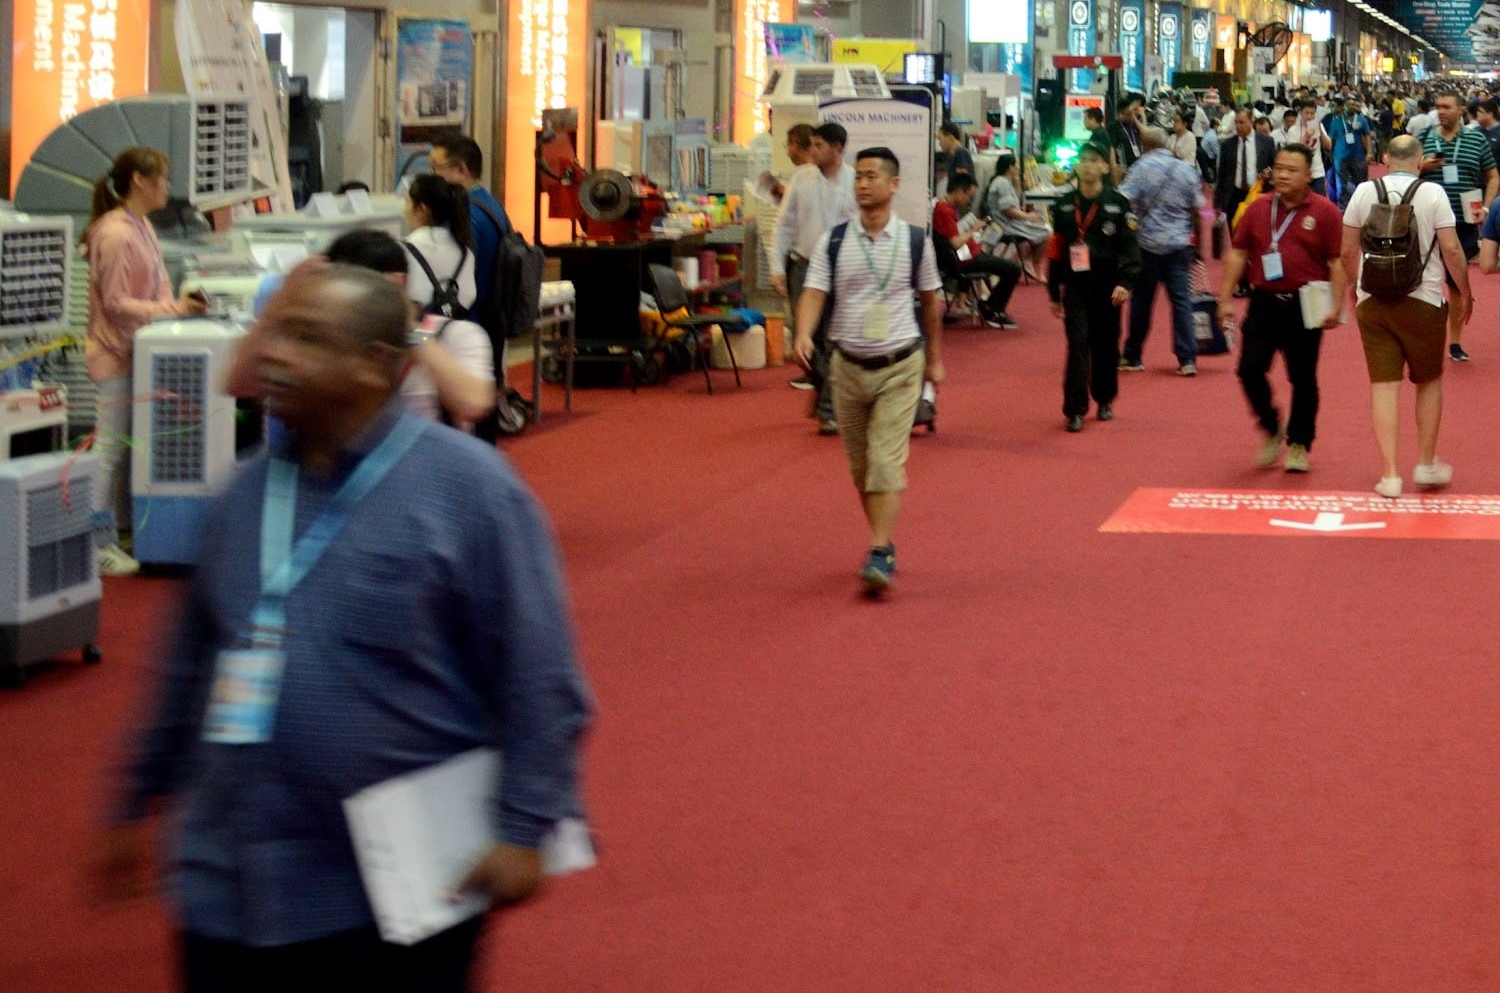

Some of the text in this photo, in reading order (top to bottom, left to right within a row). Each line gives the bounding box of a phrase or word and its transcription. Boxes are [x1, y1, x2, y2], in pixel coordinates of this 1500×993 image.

[60, 3, 87, 123] Machine
[823, 112, 924, 123] LINCOLN MACHINERY
